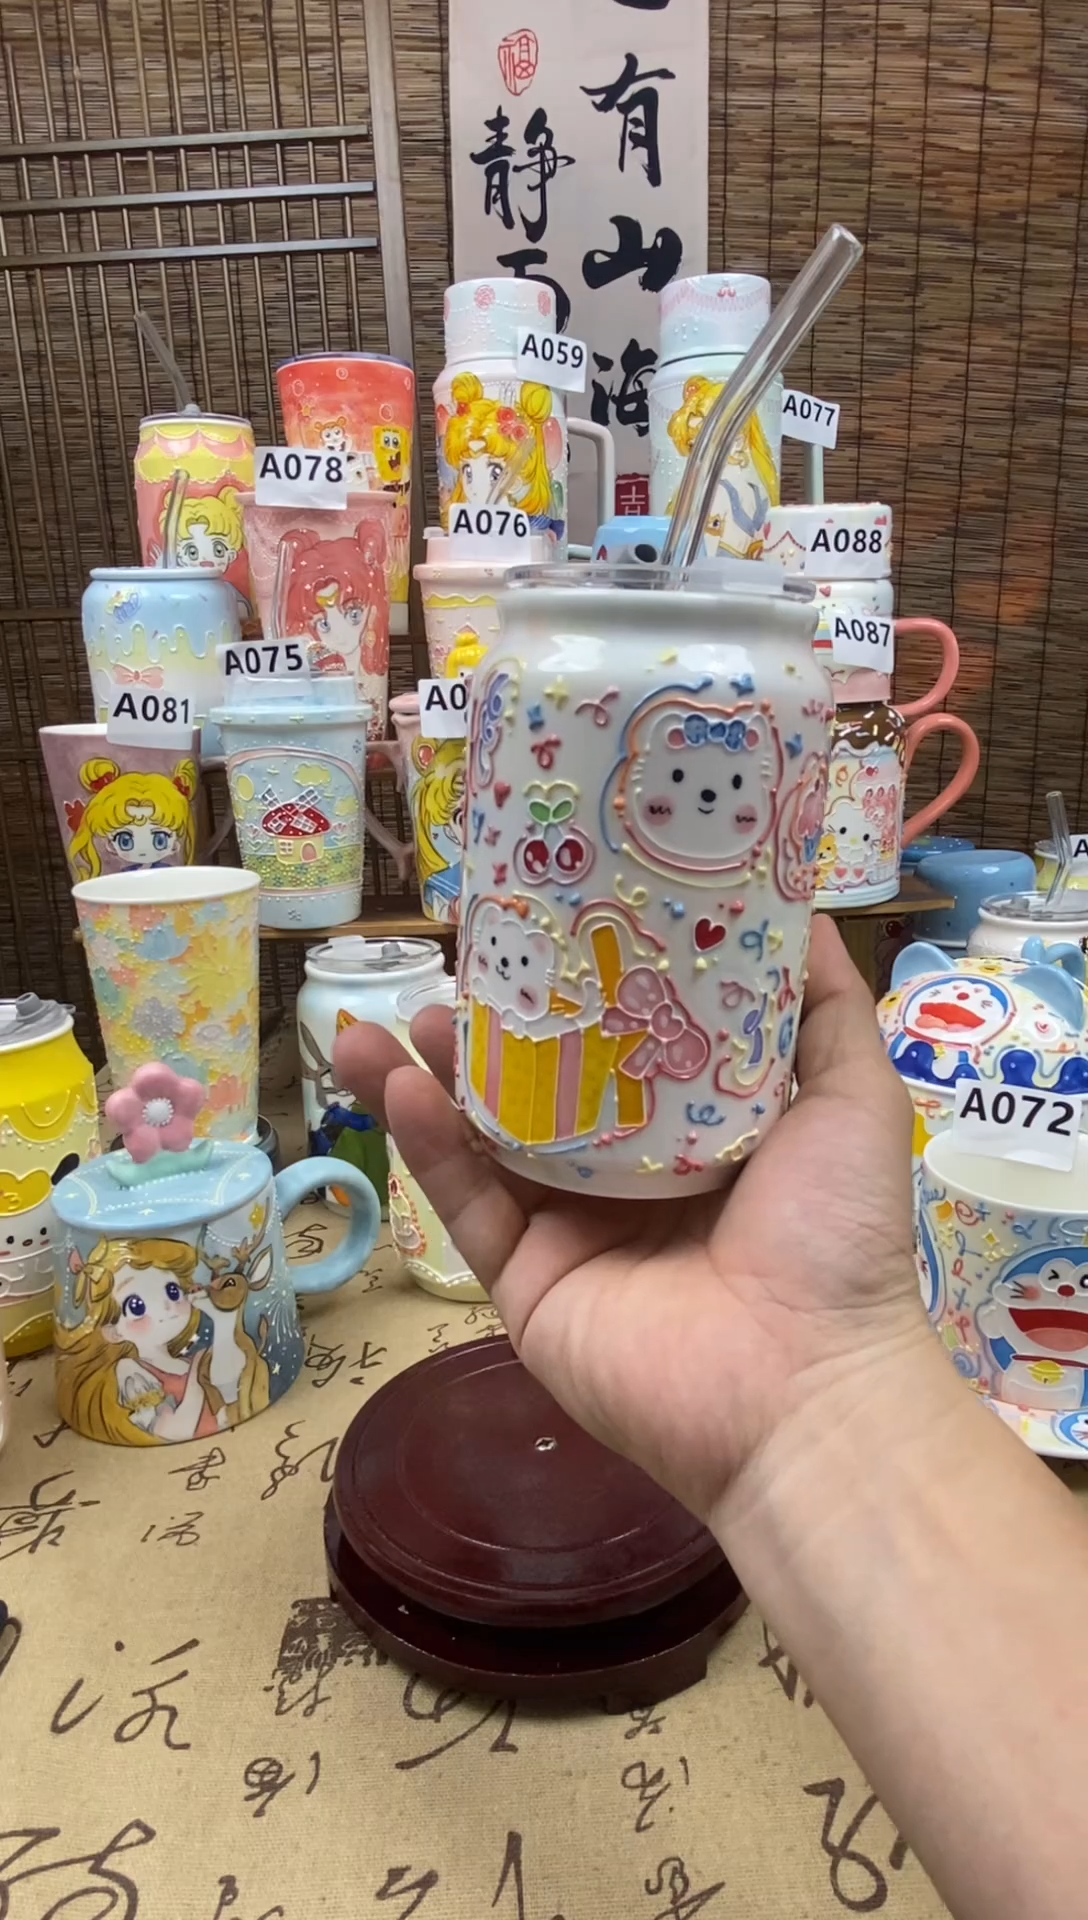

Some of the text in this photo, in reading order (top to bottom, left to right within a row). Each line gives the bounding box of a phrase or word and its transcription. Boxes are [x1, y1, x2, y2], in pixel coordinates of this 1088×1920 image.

[521, 333, 584, 368] A059
[783, 395, 836, 426] A077
[259, 452, 343, 483] A078
[453, 509, 528, 538] A076
[810, 528, 883, 554] A088
[833, 617, 892, 647] A087
[224, 643, 303, 676] A075
[112, 692, 190, 724] A081
[959, 1087, 1076, 1137] A072
